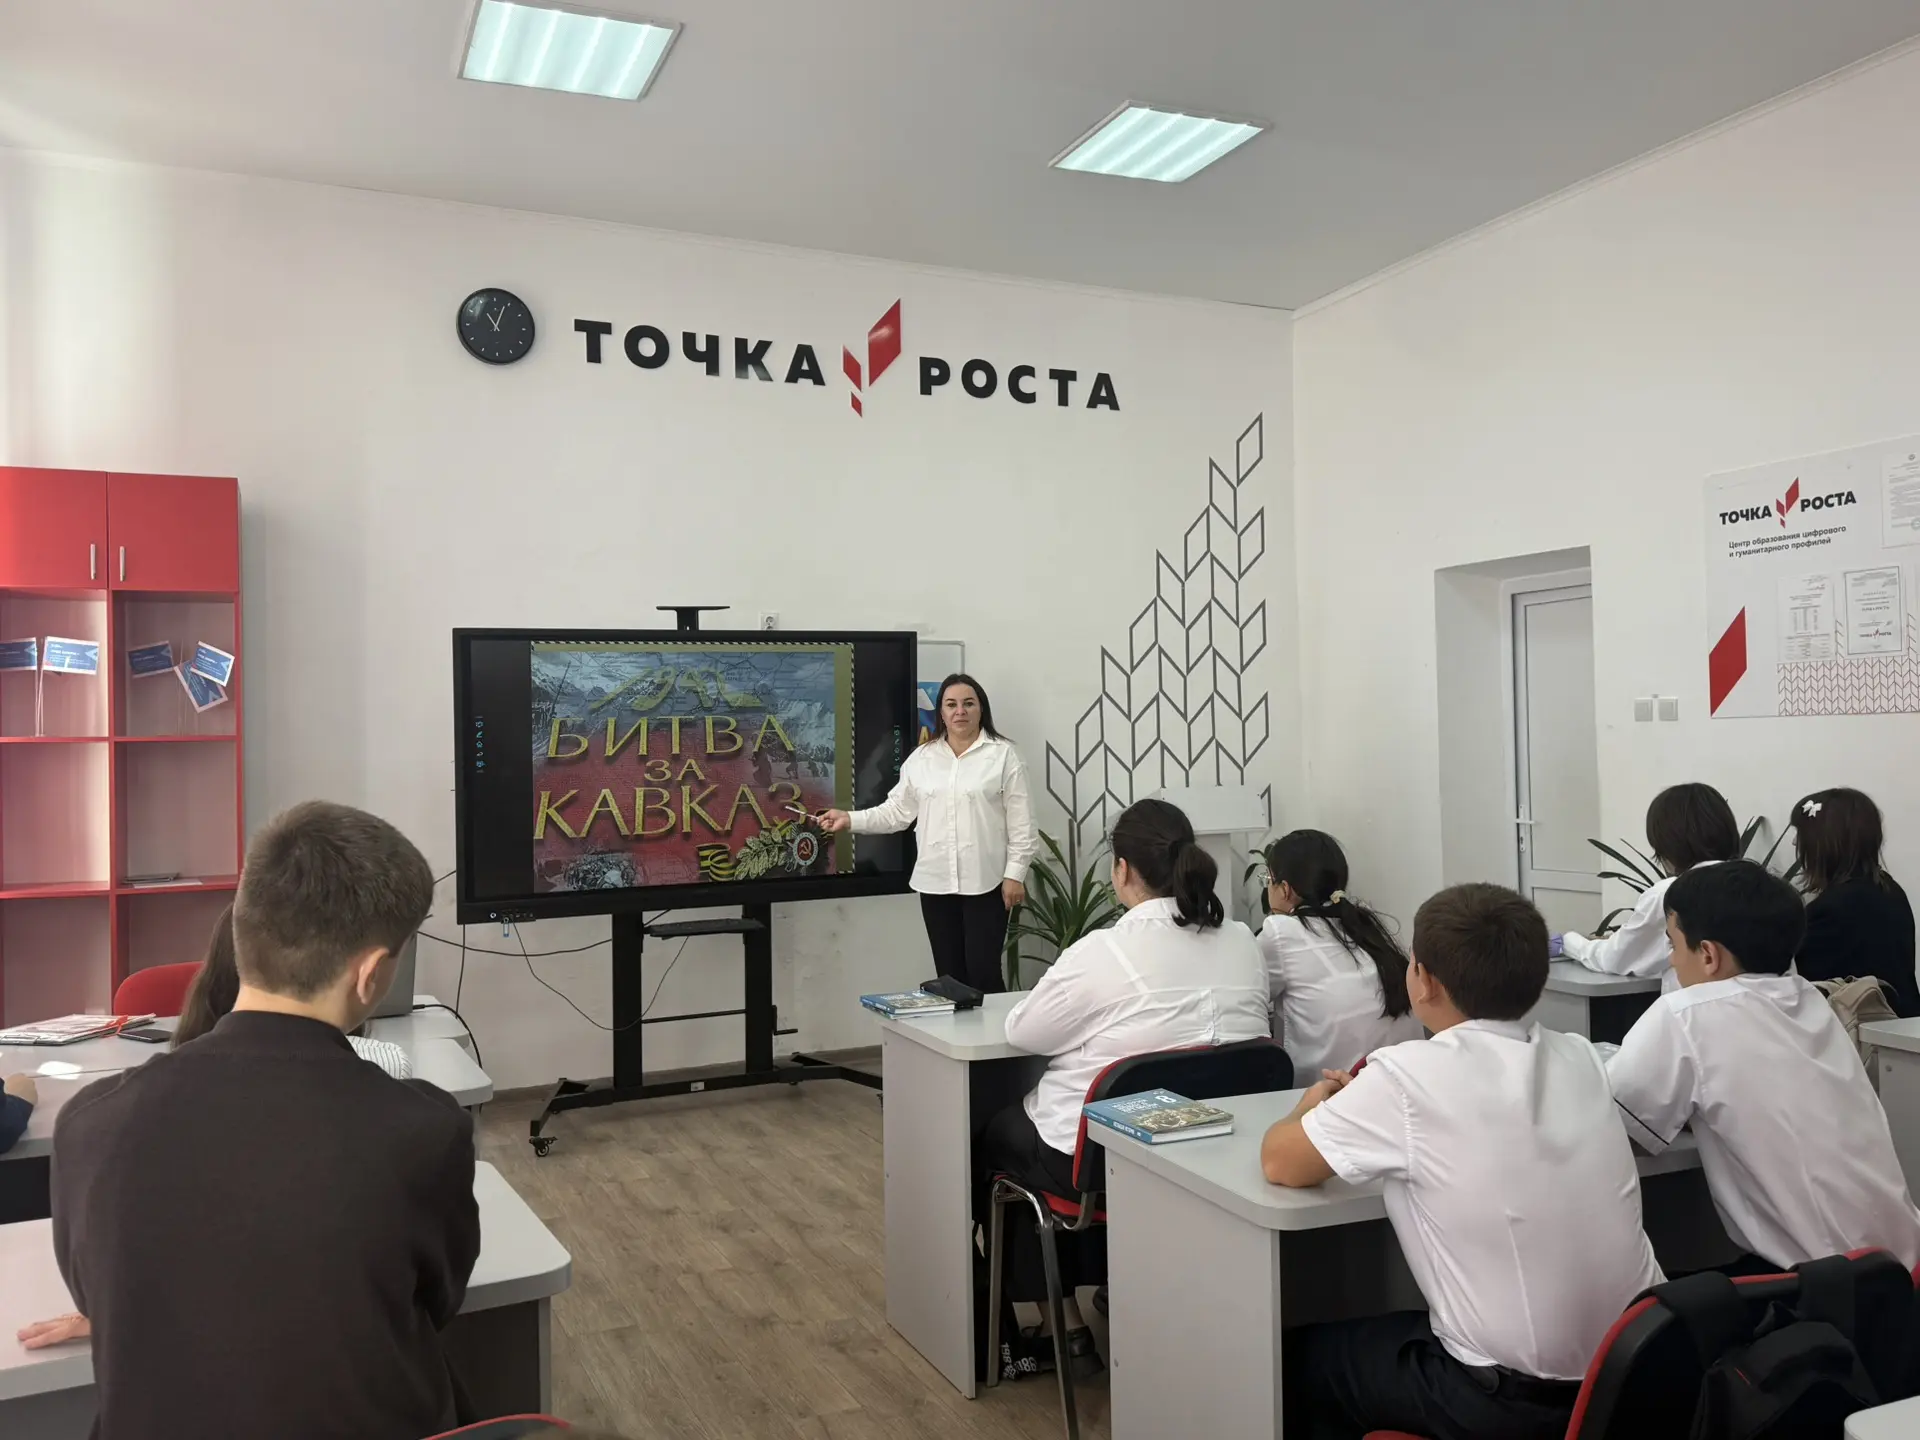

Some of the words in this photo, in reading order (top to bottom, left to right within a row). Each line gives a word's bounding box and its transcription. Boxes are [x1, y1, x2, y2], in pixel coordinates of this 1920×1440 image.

[574, 318, 826, 386] ТОЧКА
[918, 356, 1120, 411] РОСТА
[1719, 505, 1772, 525] ТОЧКА
[1800, 490, 1857, 512] РОСТА
[1729, 541, 1751, 549] Центр
[1752, 532, 1800, 547] образования
[1802, 525, 1847, 538] цифрового
[1735, 543, 1790, 558] гуманитарного
[1791, 537, 1832, 550] профилей
[546, 714, 796, 759] БИТВА
[643, 758, 706, 782] ЗА
[532, 781, 808, 841] КАВКАЗ
